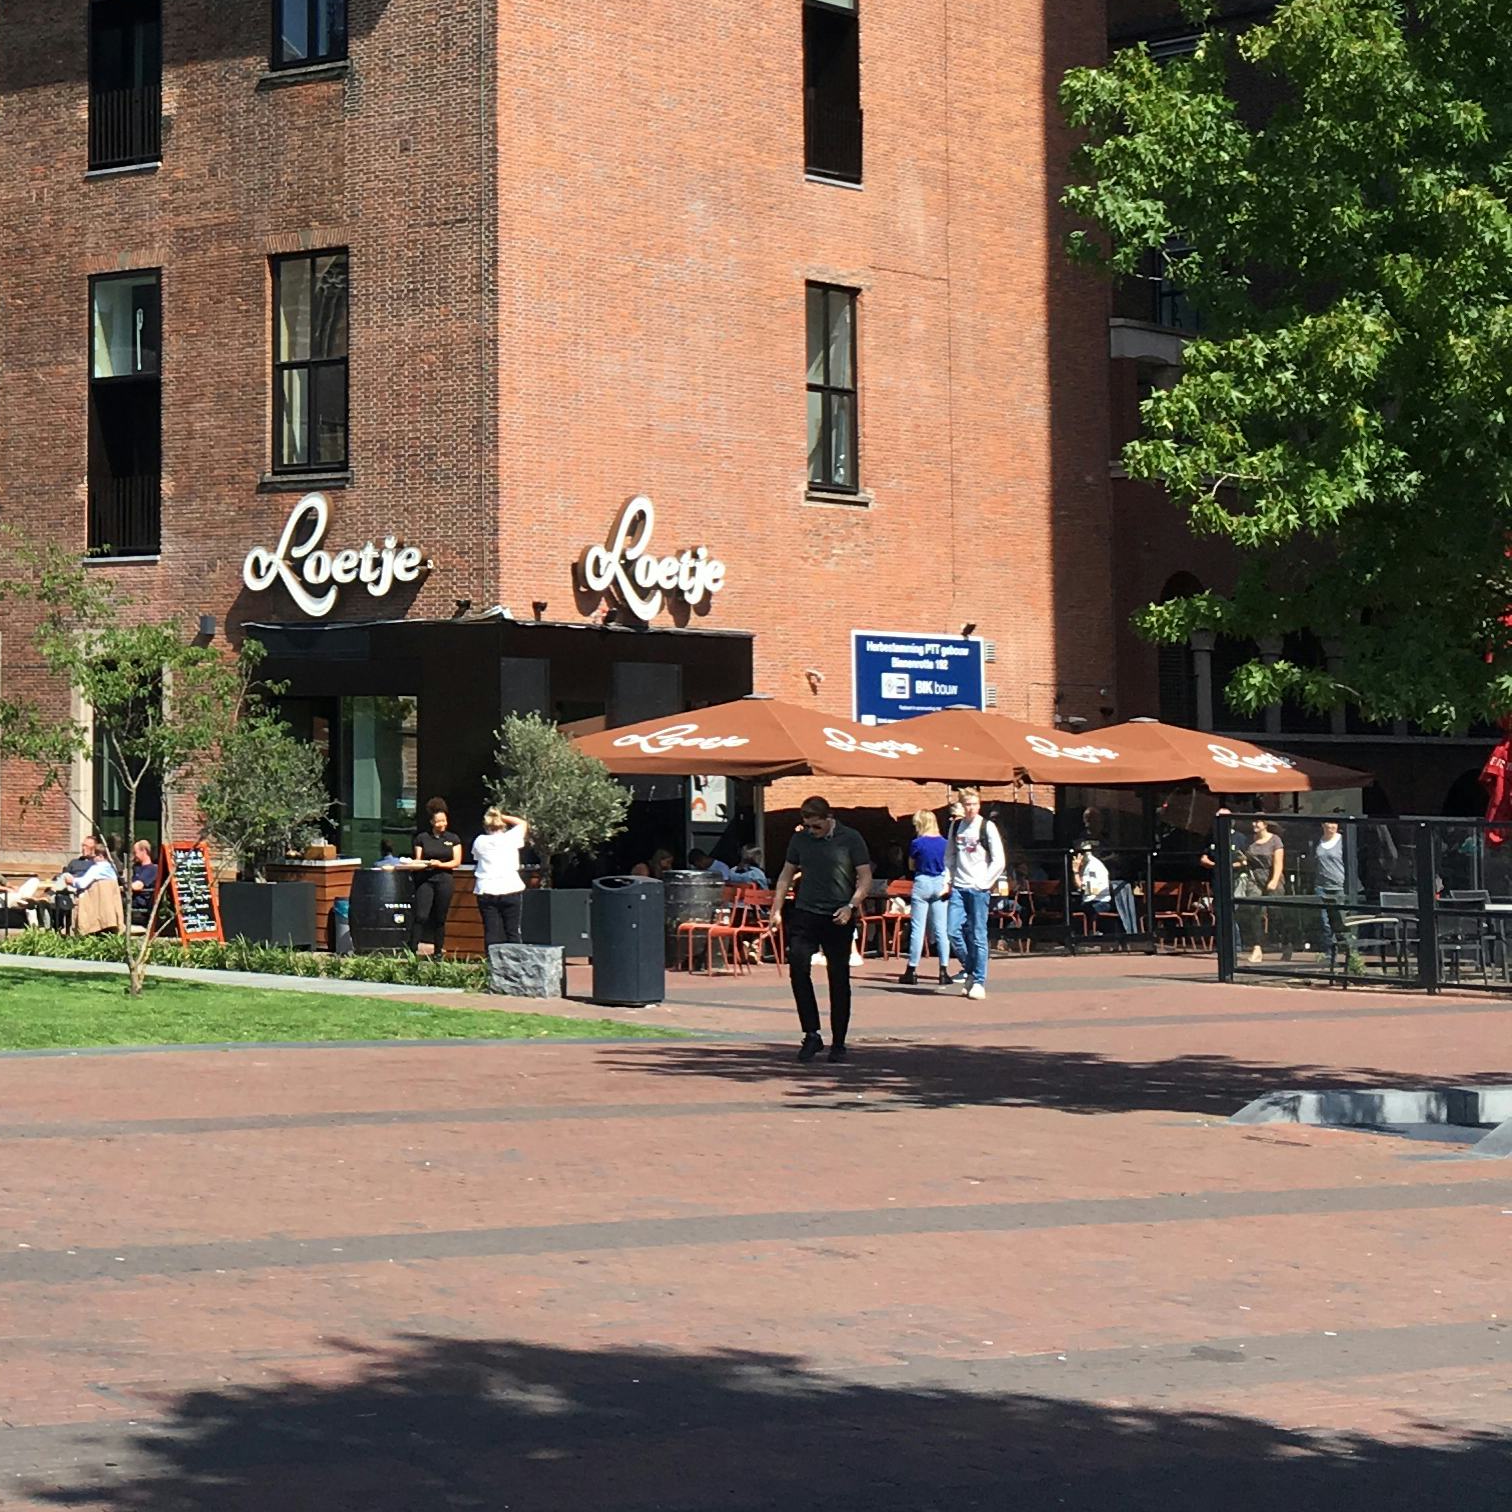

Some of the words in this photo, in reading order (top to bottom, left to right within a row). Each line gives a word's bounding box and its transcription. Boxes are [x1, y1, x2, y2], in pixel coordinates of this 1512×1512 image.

[243, 491, 422, 617] Loetje
[584, 493, 727, 621] Loetje
[924, 643, 941, 655] PTT
[940, 645, 970, 657] gebouw
[915, 680, 934, 695] BIK
[934, 681, 959, 696] bouw
[612, 723, 750, 754] Loetje
